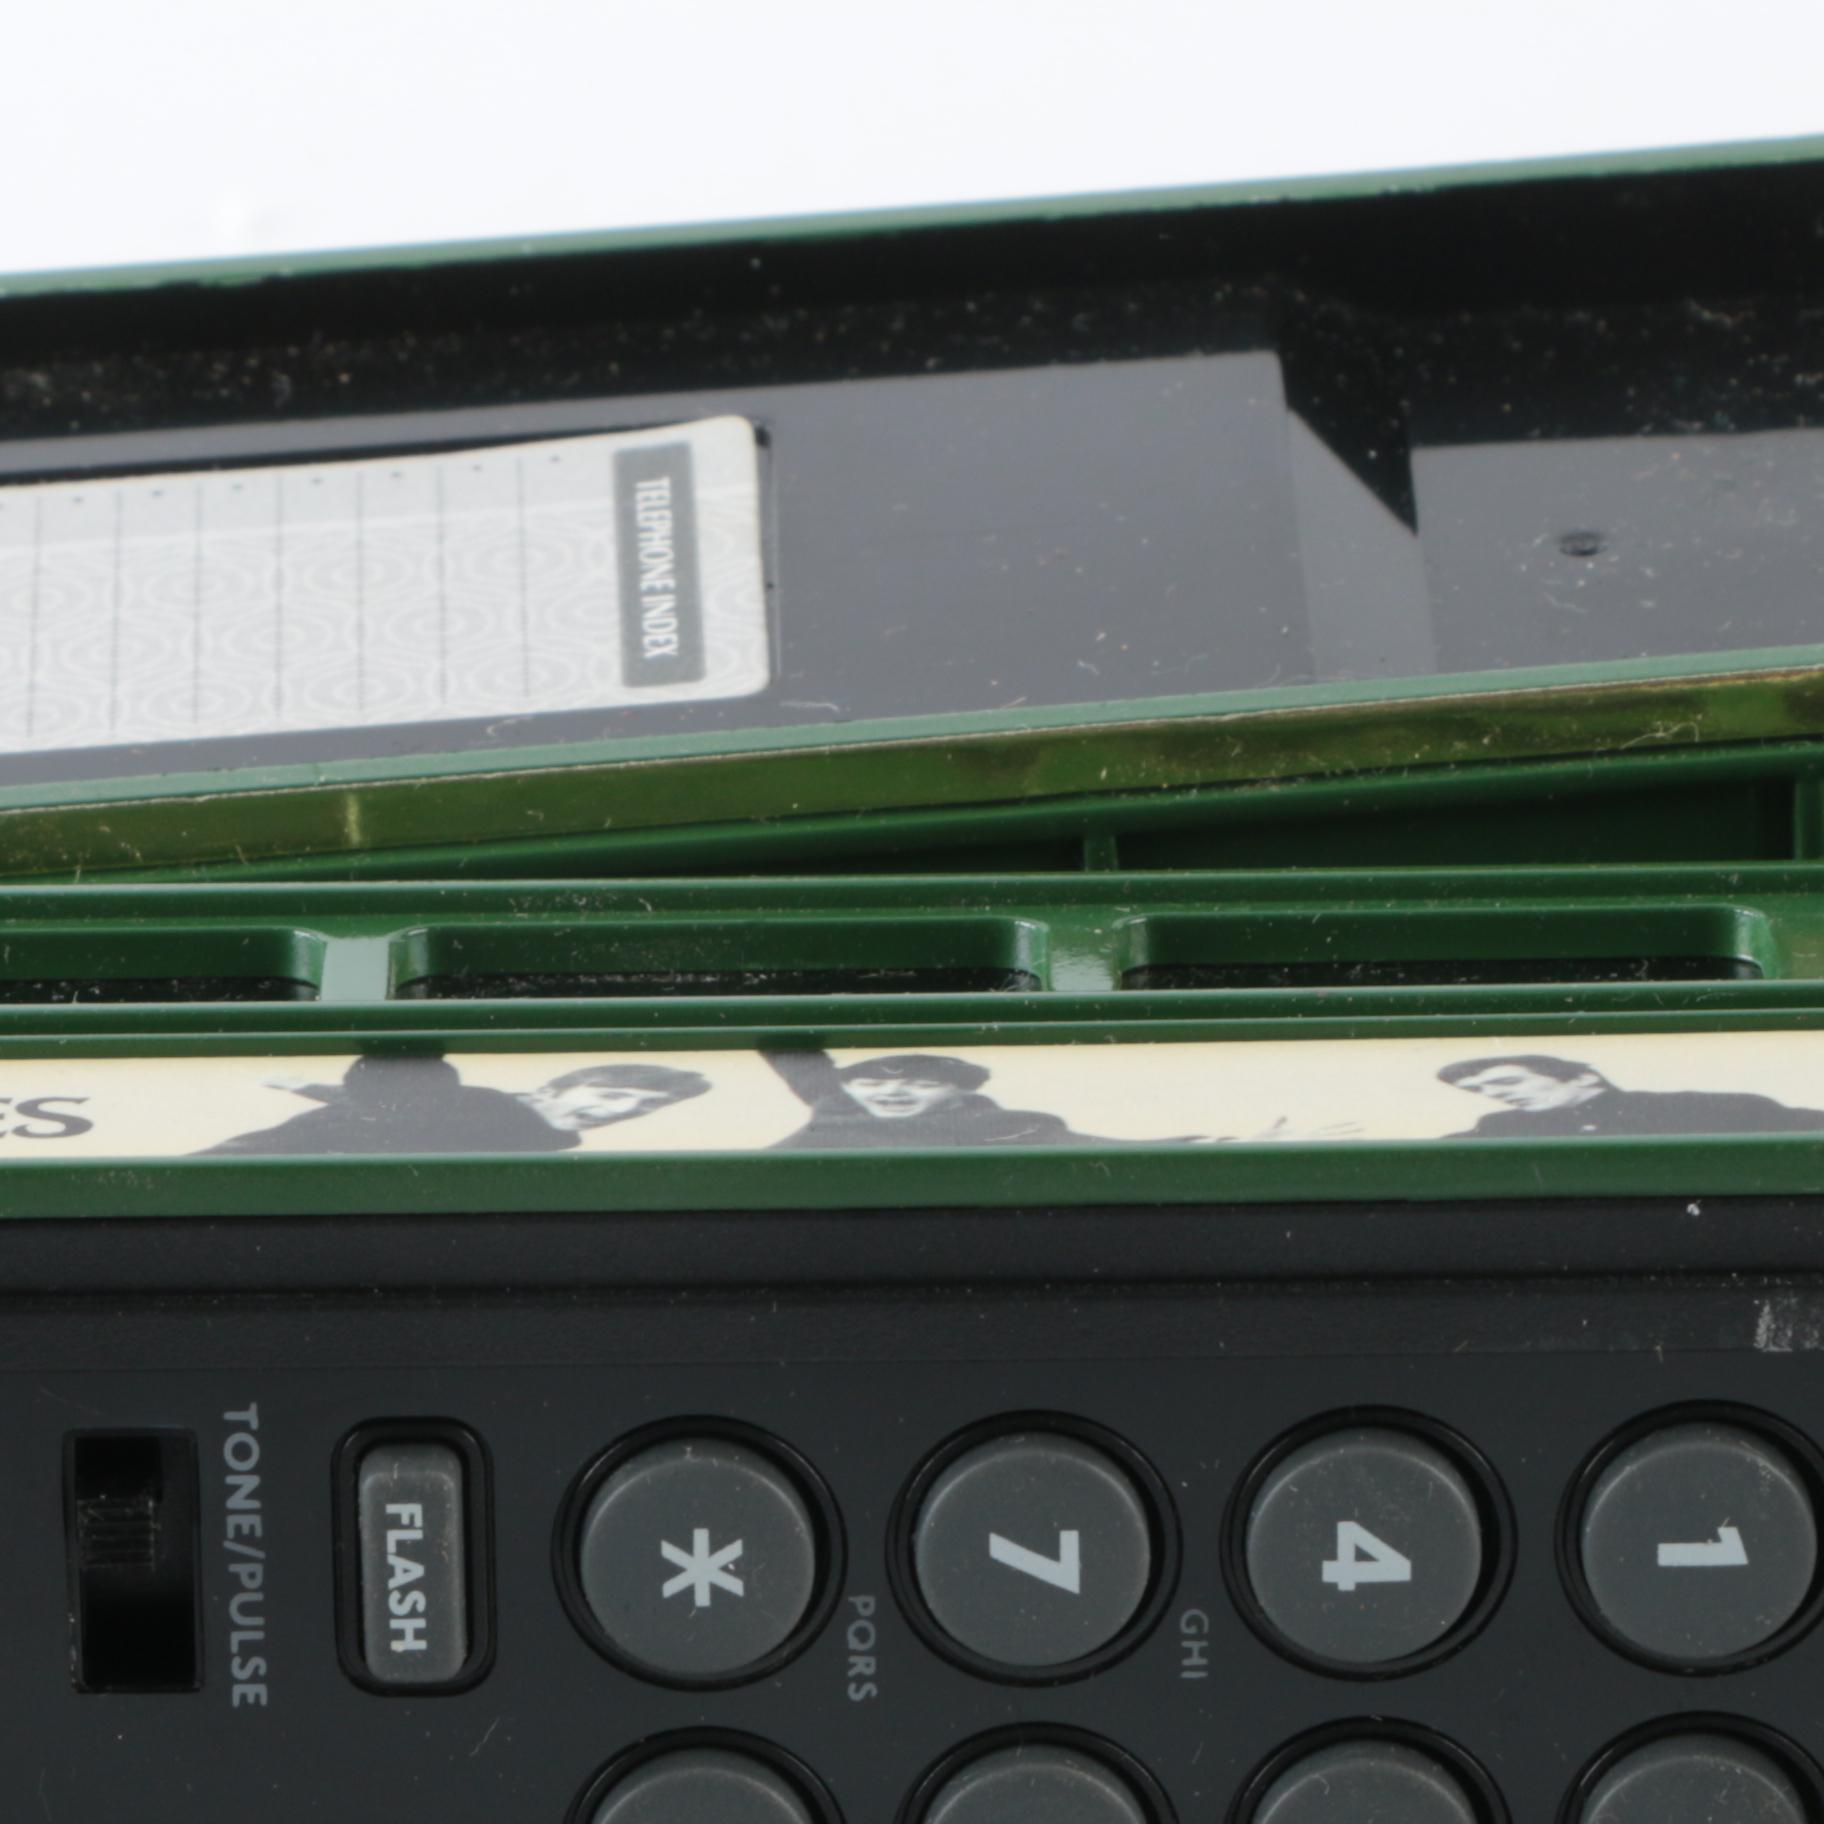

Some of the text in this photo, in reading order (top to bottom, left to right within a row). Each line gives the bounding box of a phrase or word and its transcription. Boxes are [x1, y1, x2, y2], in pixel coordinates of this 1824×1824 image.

[635, 476, 679, 658] TELEPHONE INDEX
[223, 1403, 268, 1708] TONE/PULSE
[385, 1502, 428, 1652] FLASH
[989, 1530, 1080, 1595] 7
[1322, 1521, 1412, 1591] 4
[1657, 1526, 1749, 1566] 1
[847, 1595, 876, 1701] PQRS
[1180, 1608, 1210, 1680] GHI
